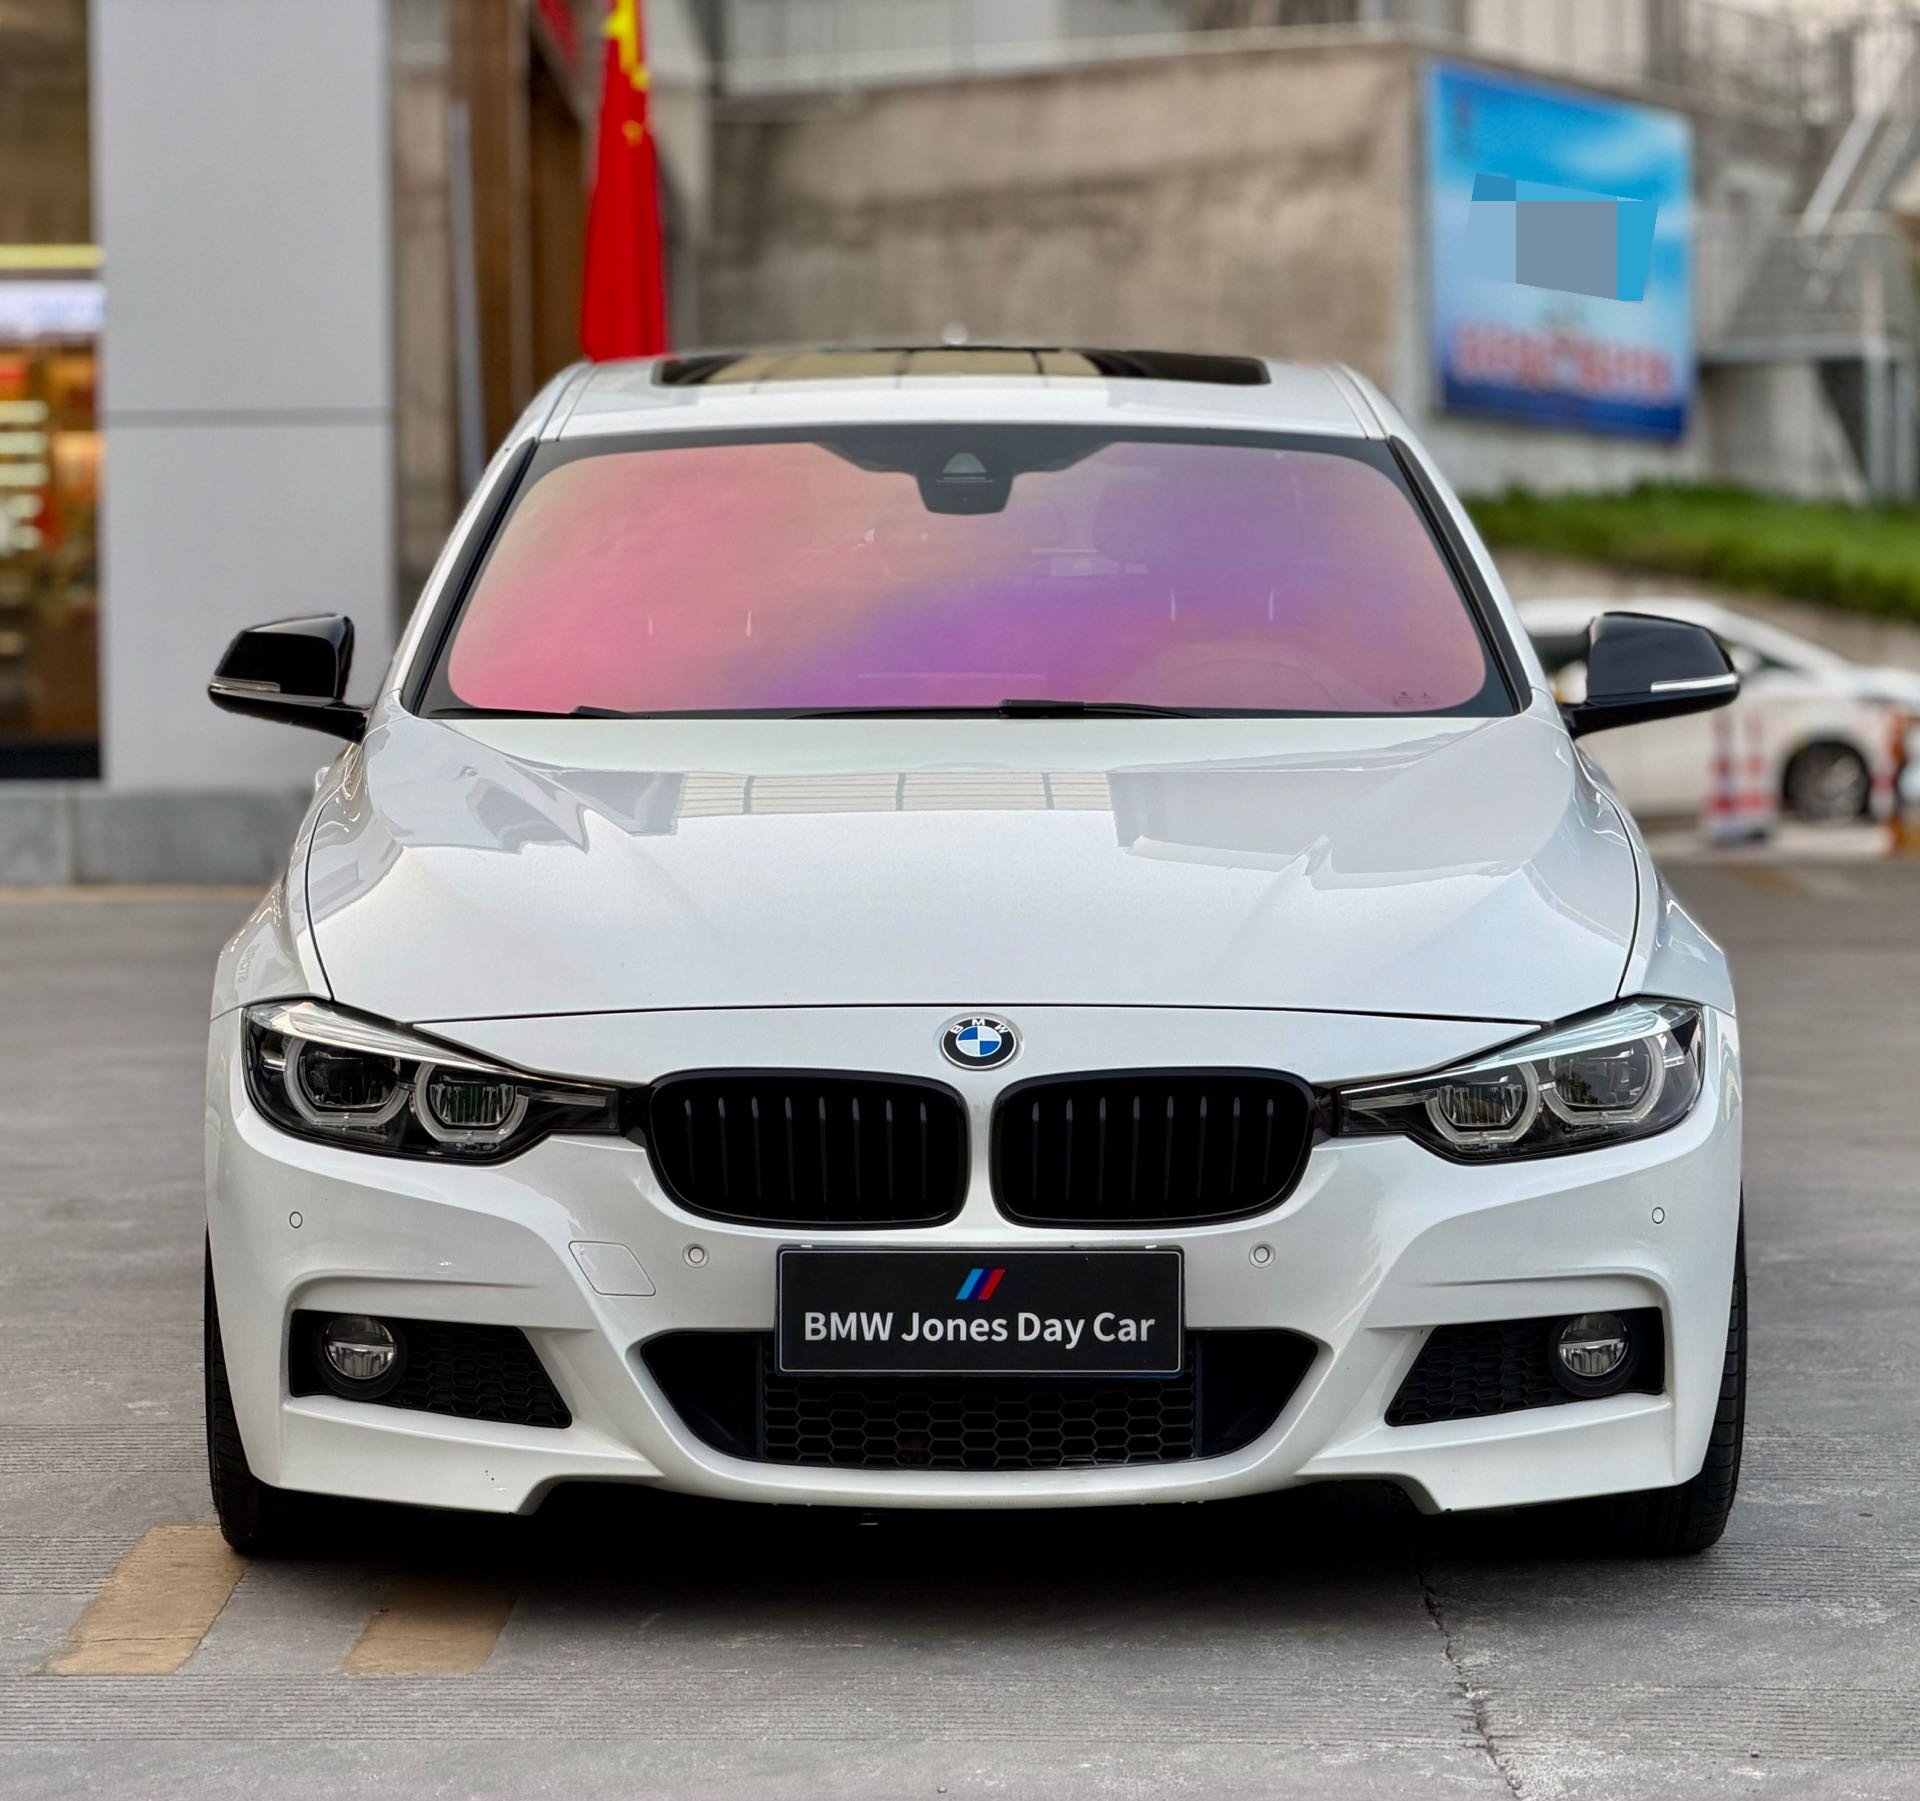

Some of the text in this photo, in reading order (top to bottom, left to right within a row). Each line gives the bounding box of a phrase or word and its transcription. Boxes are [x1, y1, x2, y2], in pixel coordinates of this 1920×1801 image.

[949, 1017, 1009, 1034] BMW
[804, 1311, 1155, 1350] BMW Jones Day Car
